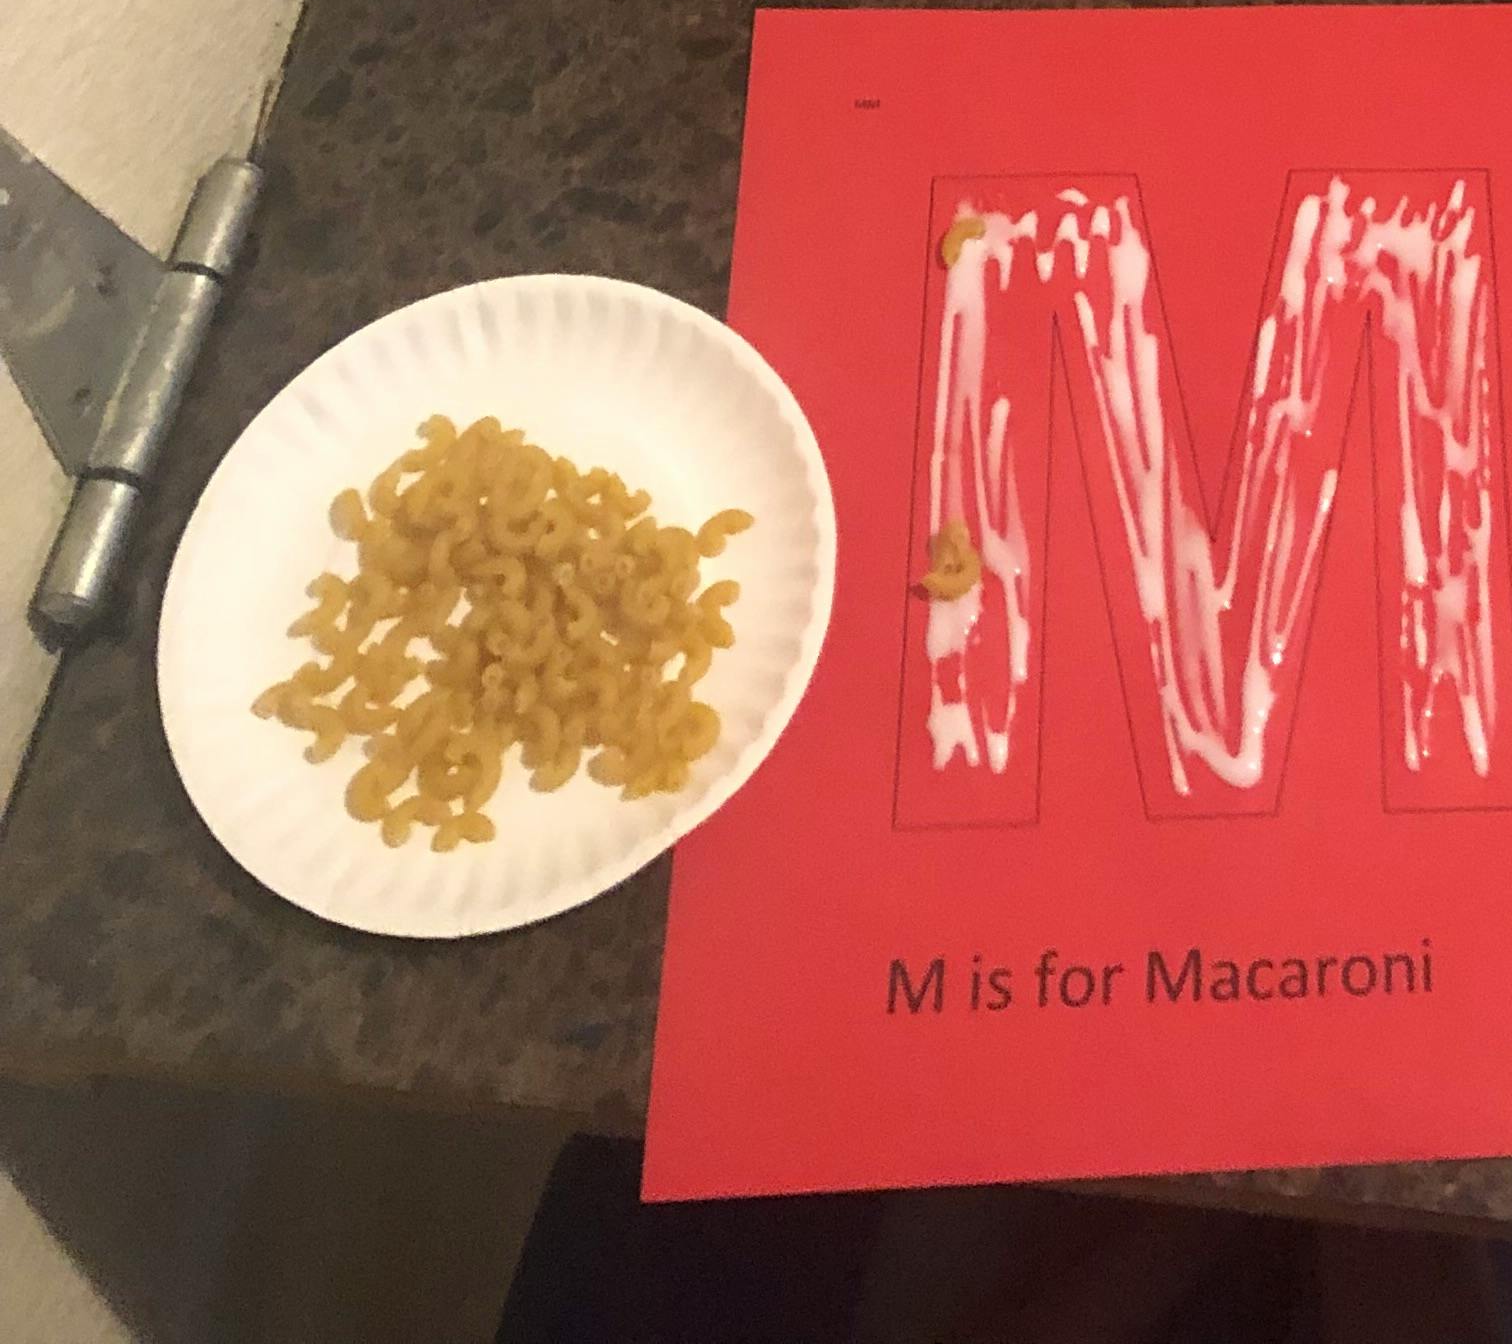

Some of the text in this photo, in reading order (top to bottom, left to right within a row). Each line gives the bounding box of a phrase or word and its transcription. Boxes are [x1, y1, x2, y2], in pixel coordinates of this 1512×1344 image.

[886, 936, 1434, 1015] M is for Macaroni
